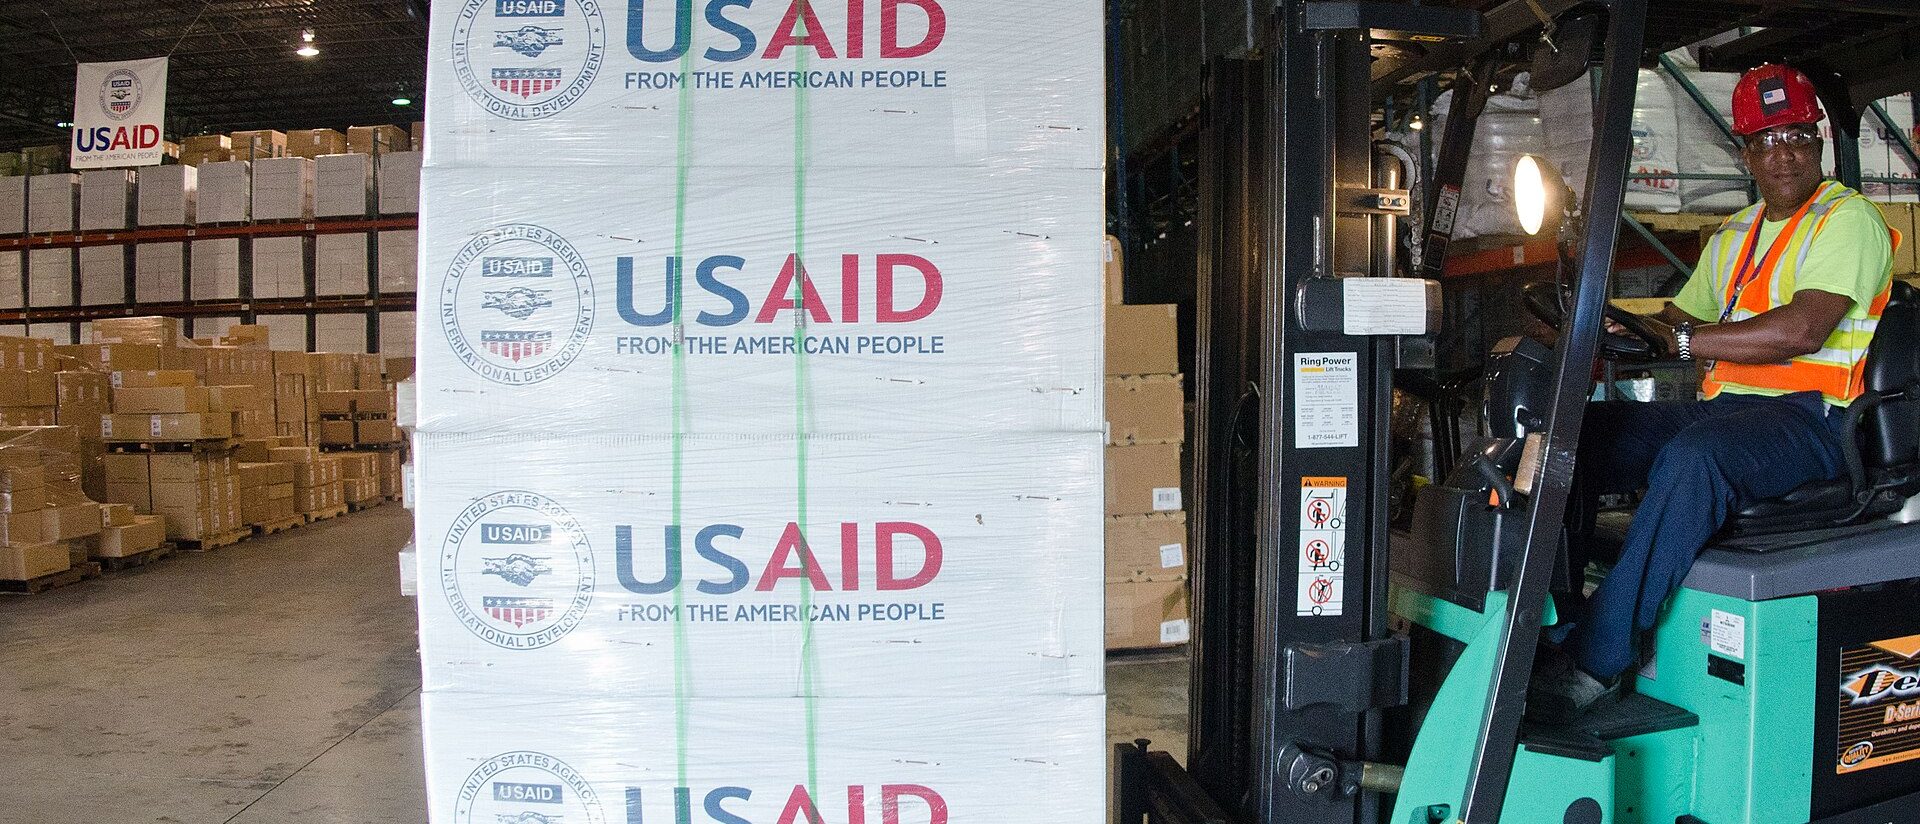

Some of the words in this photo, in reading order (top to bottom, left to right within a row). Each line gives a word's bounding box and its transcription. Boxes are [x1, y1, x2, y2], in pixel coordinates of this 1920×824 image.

[502, 0, 555, 14] USAID
[626, 0, 947, 63] USAID
[455, 42, 529, 118] INTERNATIONAL
[532, 44, 602, 118] DEVELOPMENT
[625, 71, 686, 90] FROM
[693, 71, 734, 89] THE
[739, 71, 853, 89] AMERICAN
[861, 70, 947, 88] PEOPLE
[76, 124, 160, 152] USAID
[450, 235, 490, 279] UNITED
[543, 234, 588, 279] AGENCY
[489, 259, 543, 274] USAID
[616, 252, 944, 327] USAID
[443, 303, 520, 382] INTERNATIONAL
[524, 306, 592, 382] DEVELOPMENT
[617, 336, 679, 355] FROM
[685, 336, 727, 355] THE
[733, 336, 849, 354] AMERICAN
[857, 336, 944, 354] PEOPLE
[1300, 357, 1321, 367] Ring
[1322, 357, 1352, 365] Power
[449, 503, 487, 545] UNITED
[490, 494, 540, 508] STATES
[488, 527, 543, 541] USAID
[616, 521, 944, 595] USAID
[444, 568, 524, 647] INTERNATIONAL
[527, 576, 592, 647] DEVELOPMENT
[618, 604, 680, 622] FROM
[686, 604, 729, 622] THE
[734, 604, 850, 622] AMERICAN
[858, 602, 945, 621] PEOPLE
[462, 760, 498, 801] UNITED
[501, 754, 550, 768] STATES
[552, 762, 597, 805] AGENCY
[500, 785, 553, 800] USAID
[625, 784, 948, 824] USAID
